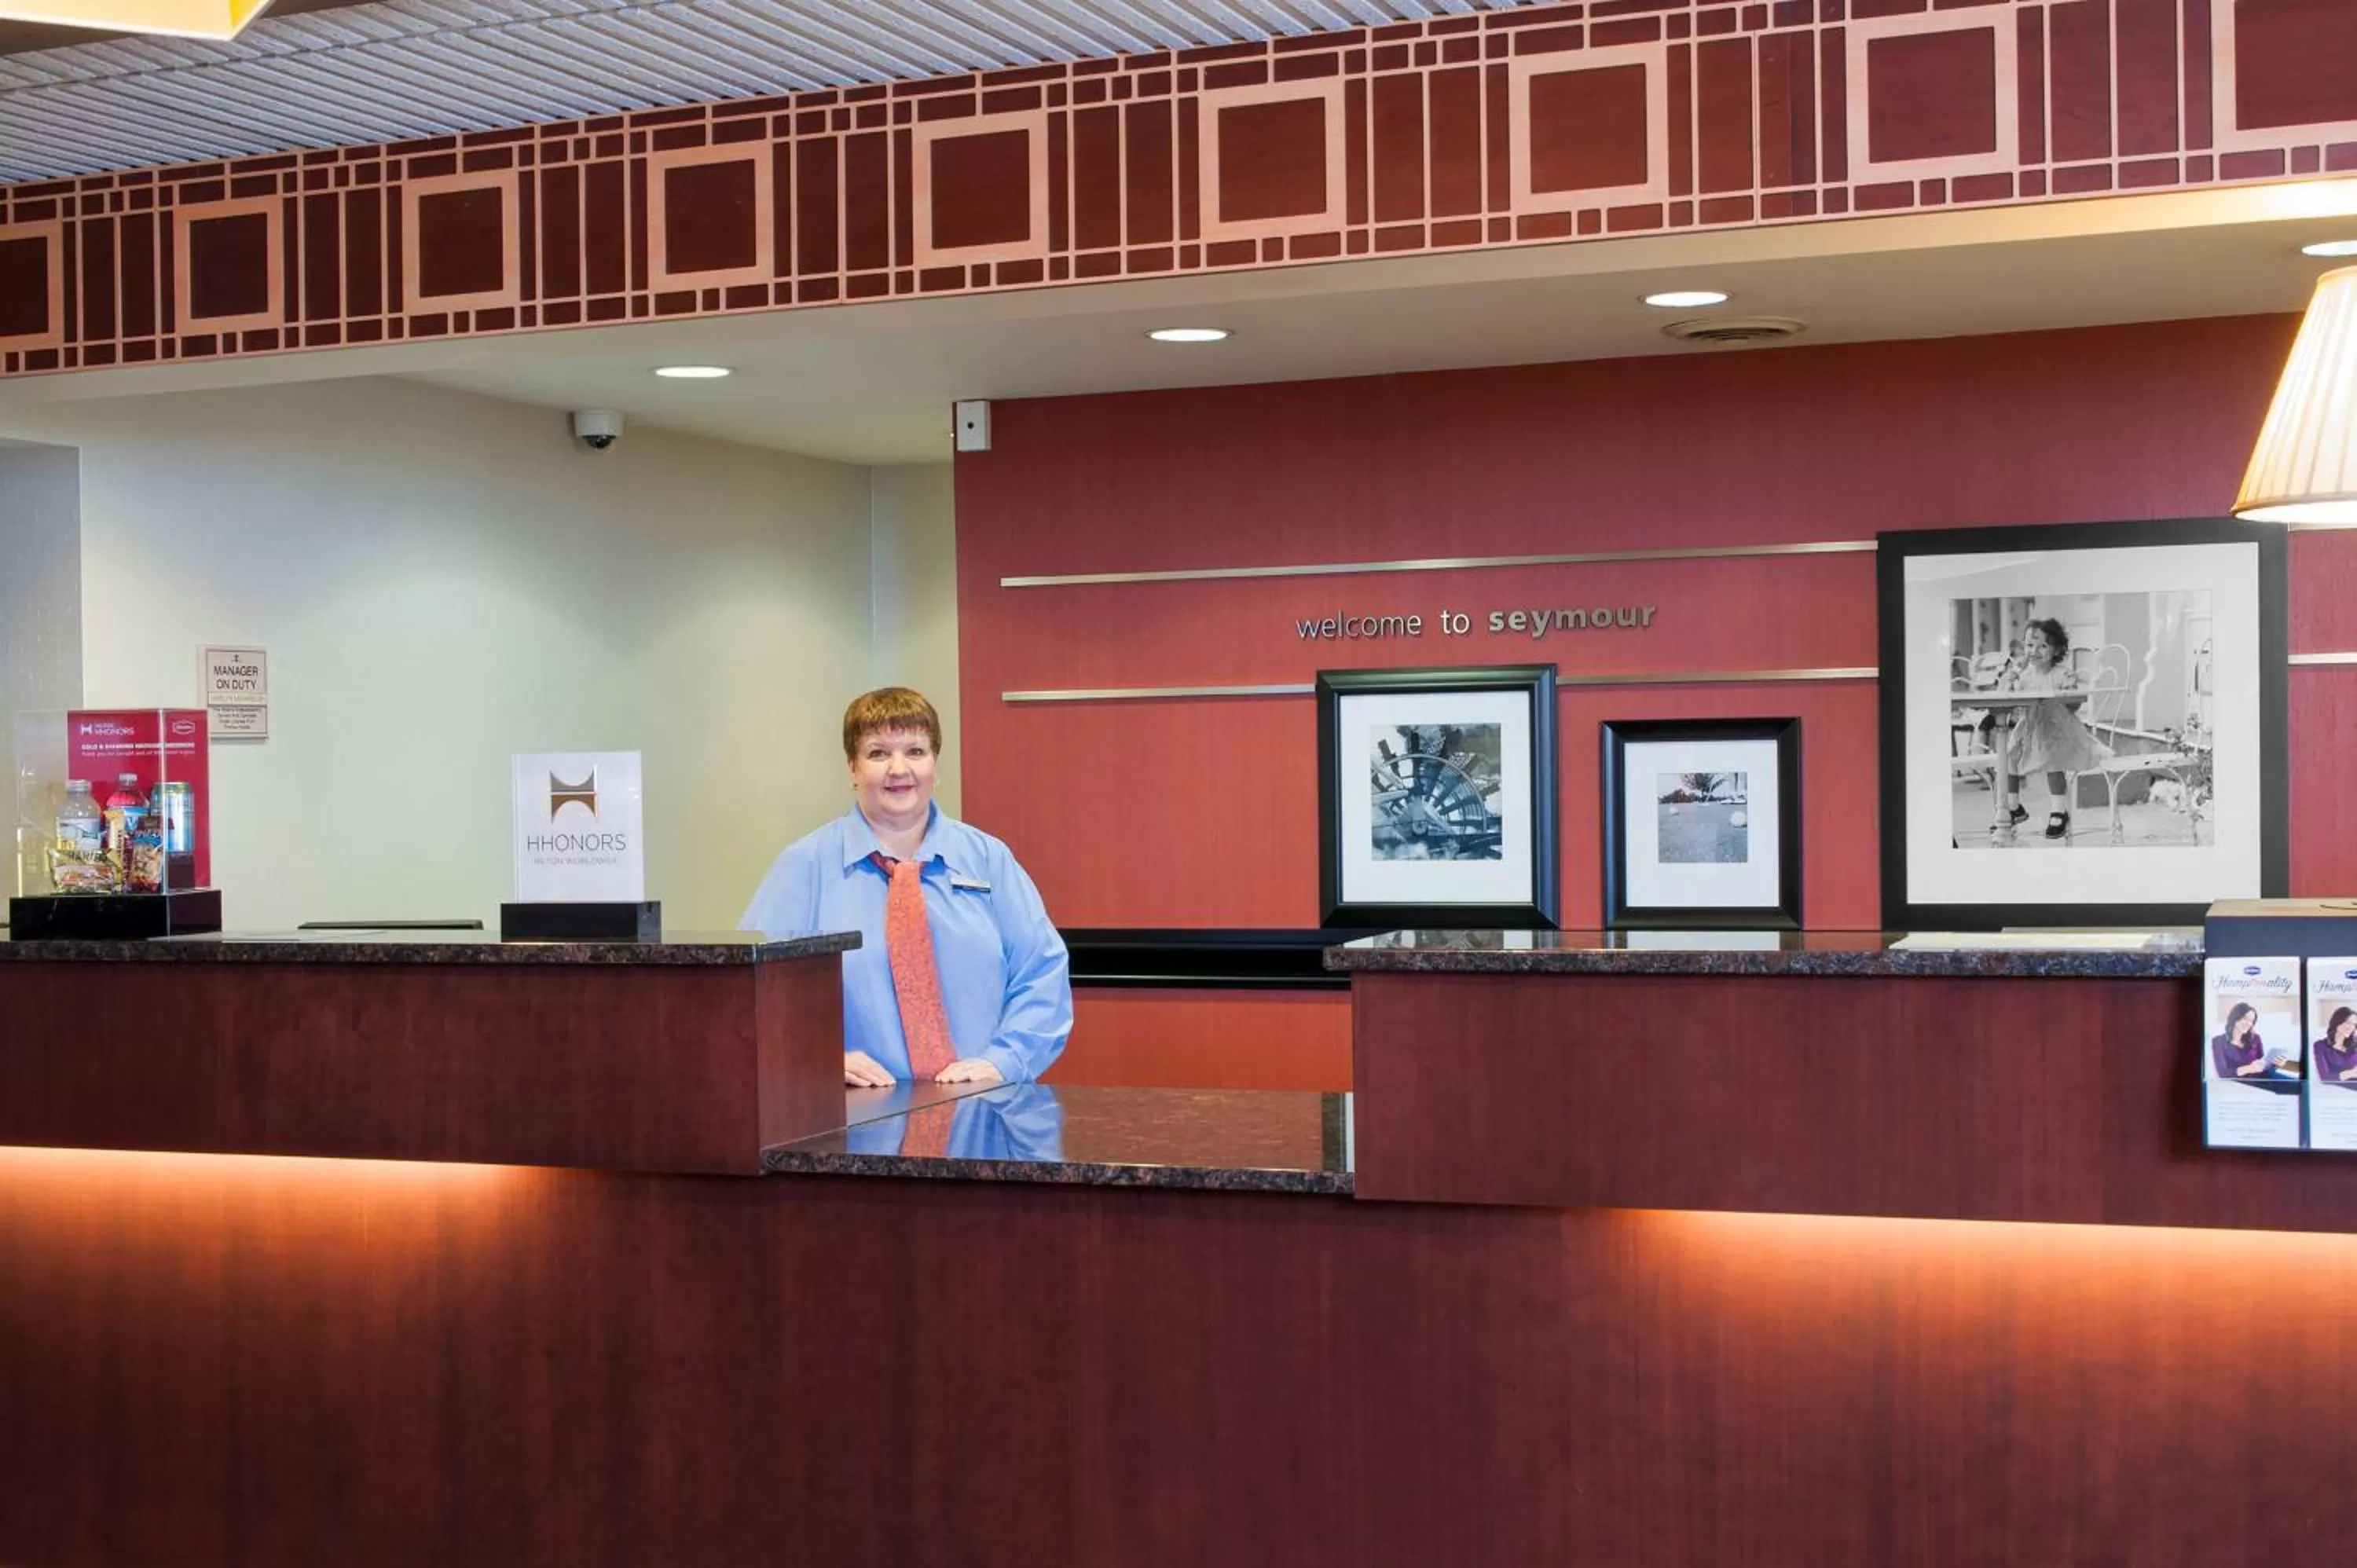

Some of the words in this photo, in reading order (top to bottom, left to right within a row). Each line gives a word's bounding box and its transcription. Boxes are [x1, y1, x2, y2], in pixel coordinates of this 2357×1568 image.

[1296, 610, 1421, 639] welcome
[1440, 608, 1470, 635] to
[1488, 604, 1656, 637] seymour
[213, 665, 258, 676] MANAGER
[216, 679, 230, 689] ON
[232, 680, 257, 691] DUTY
[527, 833, 626, 852] HHONORS
